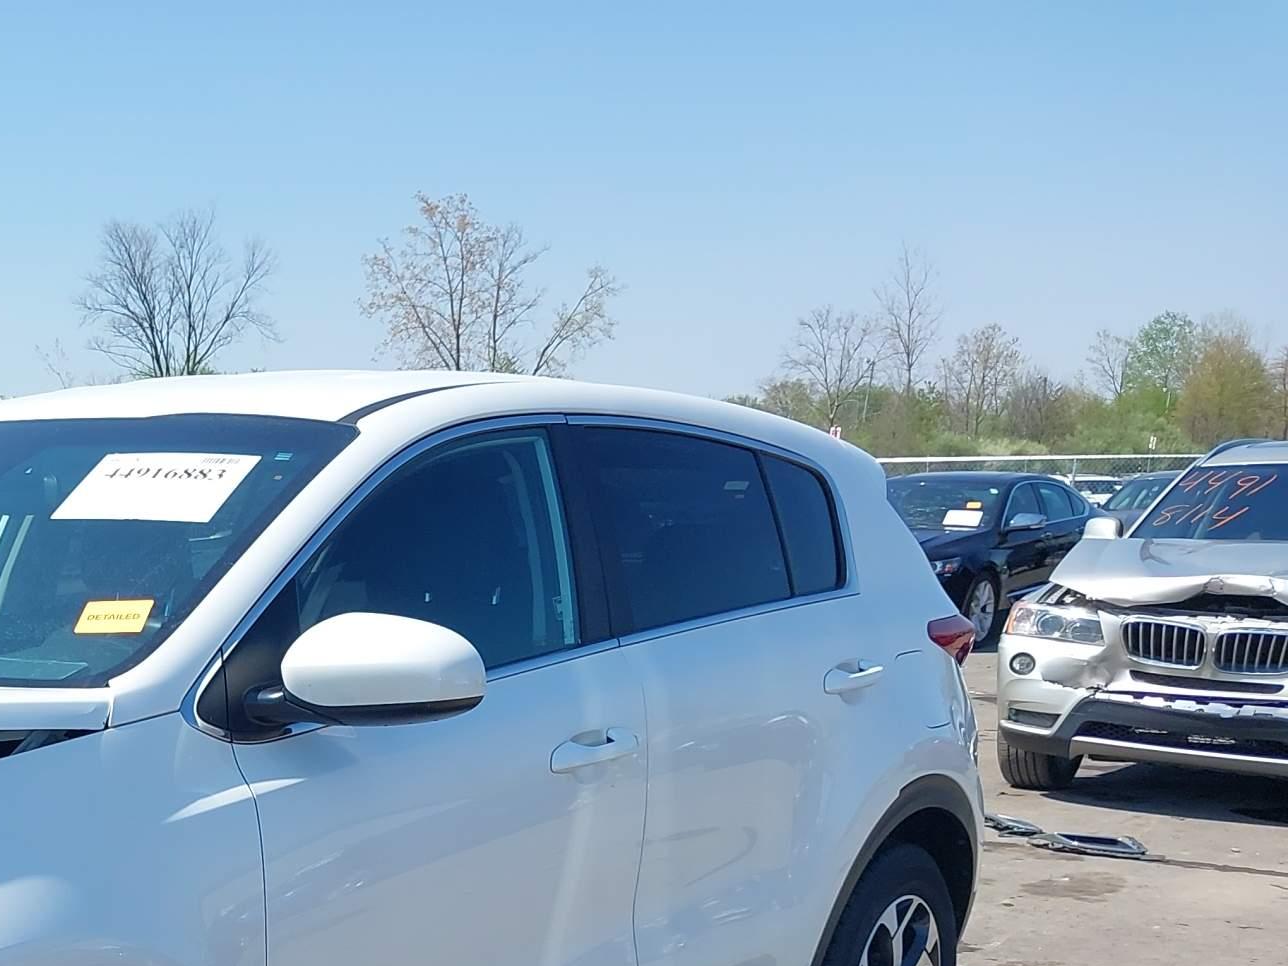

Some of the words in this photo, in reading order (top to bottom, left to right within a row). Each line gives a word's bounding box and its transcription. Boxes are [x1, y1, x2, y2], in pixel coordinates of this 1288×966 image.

[103, 467, 228, 481] 44916883
[1178, 470, 1279, 500] 4491
[1152, 503, 1250, 531] 8114
[86, 612, 142, 622] DETAILED
